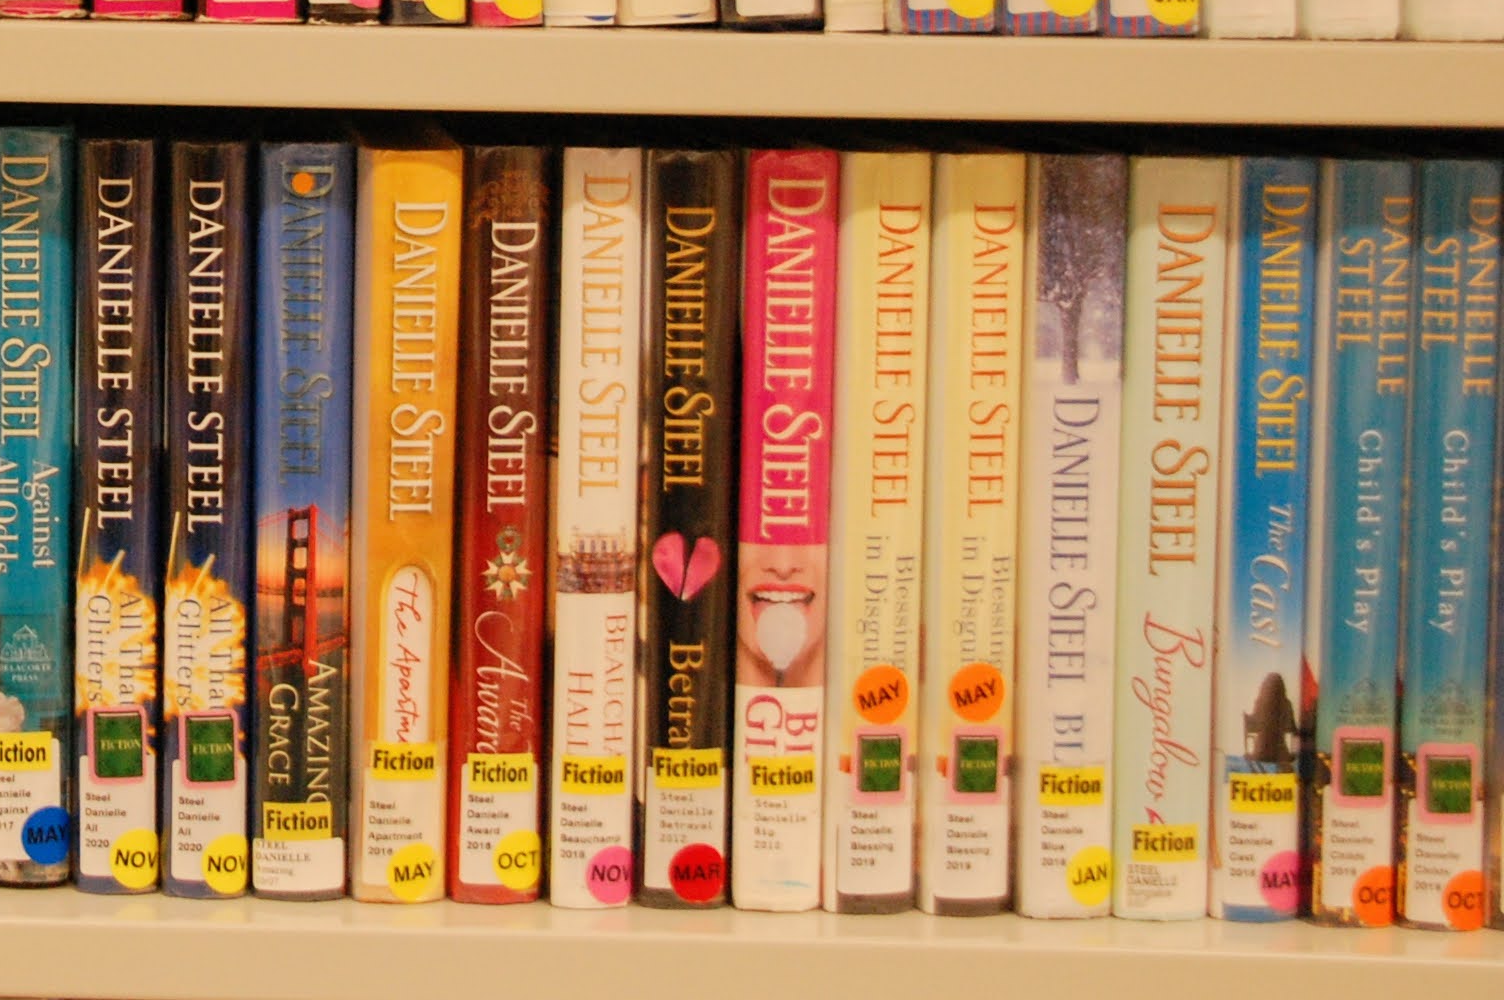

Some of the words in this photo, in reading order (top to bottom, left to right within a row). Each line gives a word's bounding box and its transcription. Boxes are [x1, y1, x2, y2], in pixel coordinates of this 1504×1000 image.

[1336, 238, 1376, 352] STEEL
[266, 683, 300, 785] GRACE
[1132, 611, 1206, 802] Bungalow
[372, 750, 435, 770] Fiction
[467, 826, 499, 836] Award
